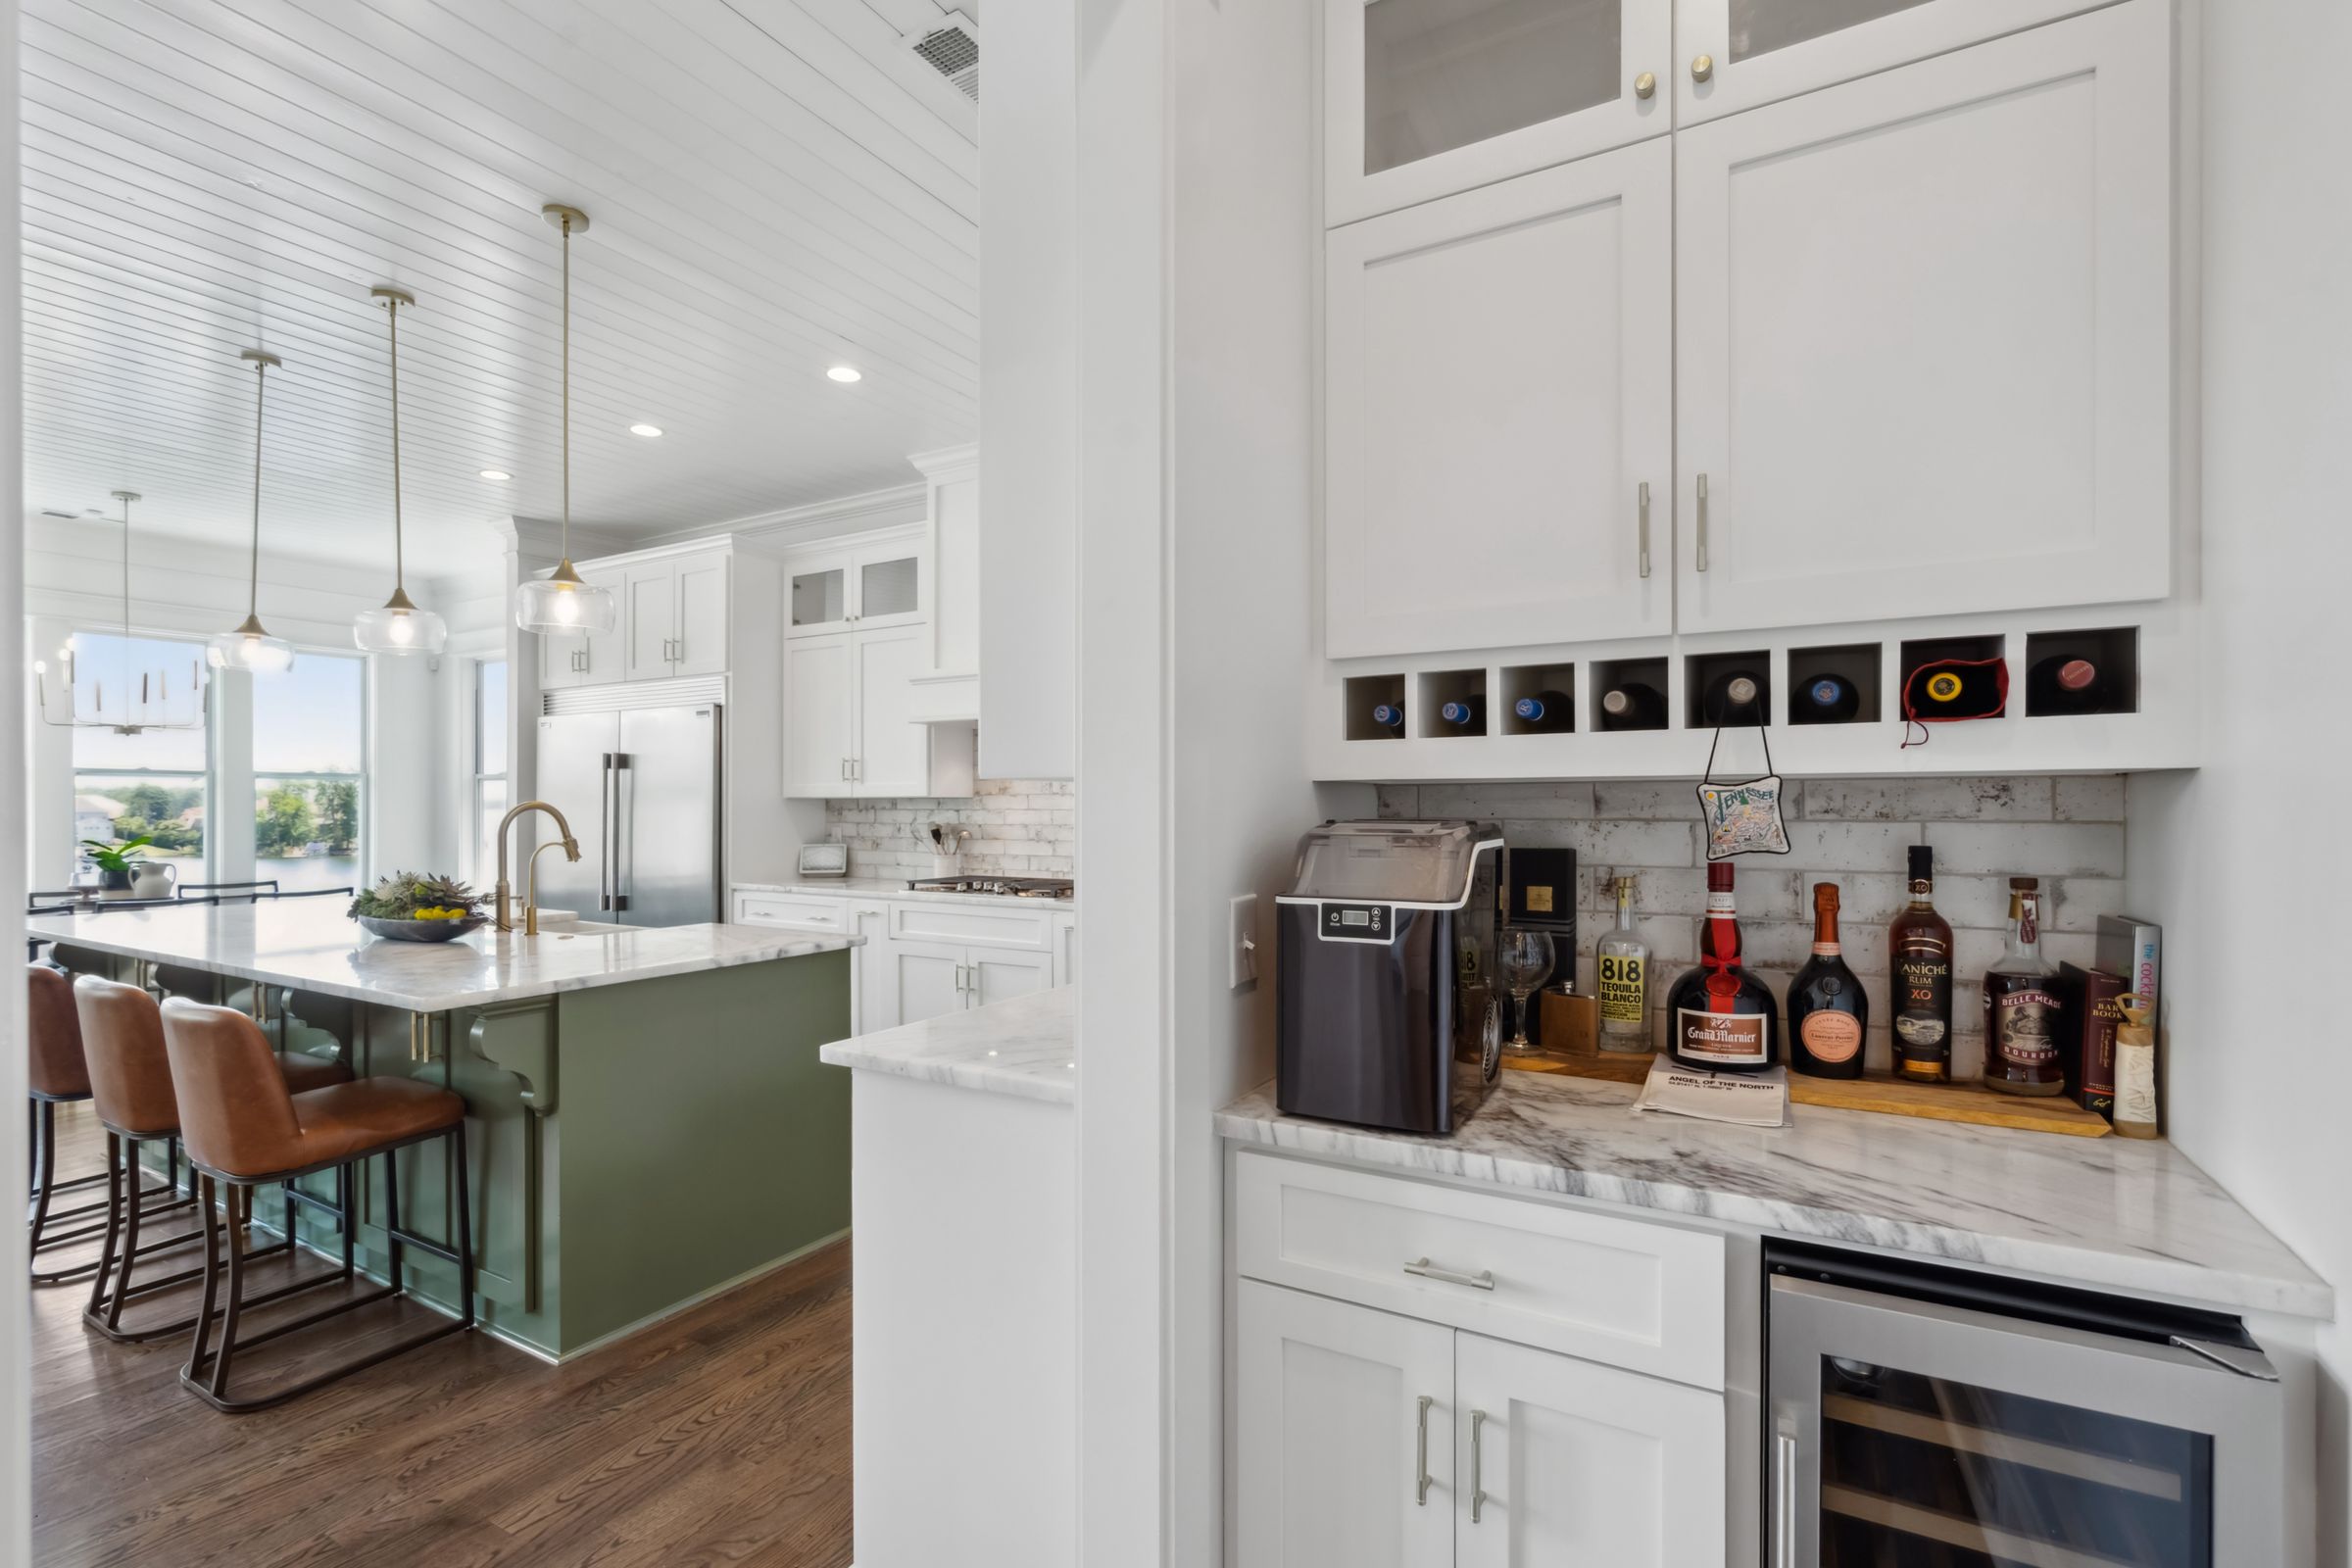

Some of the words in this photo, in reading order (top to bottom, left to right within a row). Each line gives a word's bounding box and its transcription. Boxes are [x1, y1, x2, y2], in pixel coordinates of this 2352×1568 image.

[2144, 944, 2155, 959] the
[1601, 958, 1641, 983] 818
[1908, 975, 1933, 985] RUM
[1601, 981, 1642, 994] TEQUILA
[1601, 992, 1642, 1004] BLANCO
[1912, 989, 1932, 1000] XO
[2002, 995, 2032, 1006] BELLE
[2034, 995, 2062, 1009] MEADE
[2097, 1003, 2119, 1012] BAR
[2092, 1008, 2123, 1019] BOOK
[1669, 1075, 1700, 1085] ANGEL
